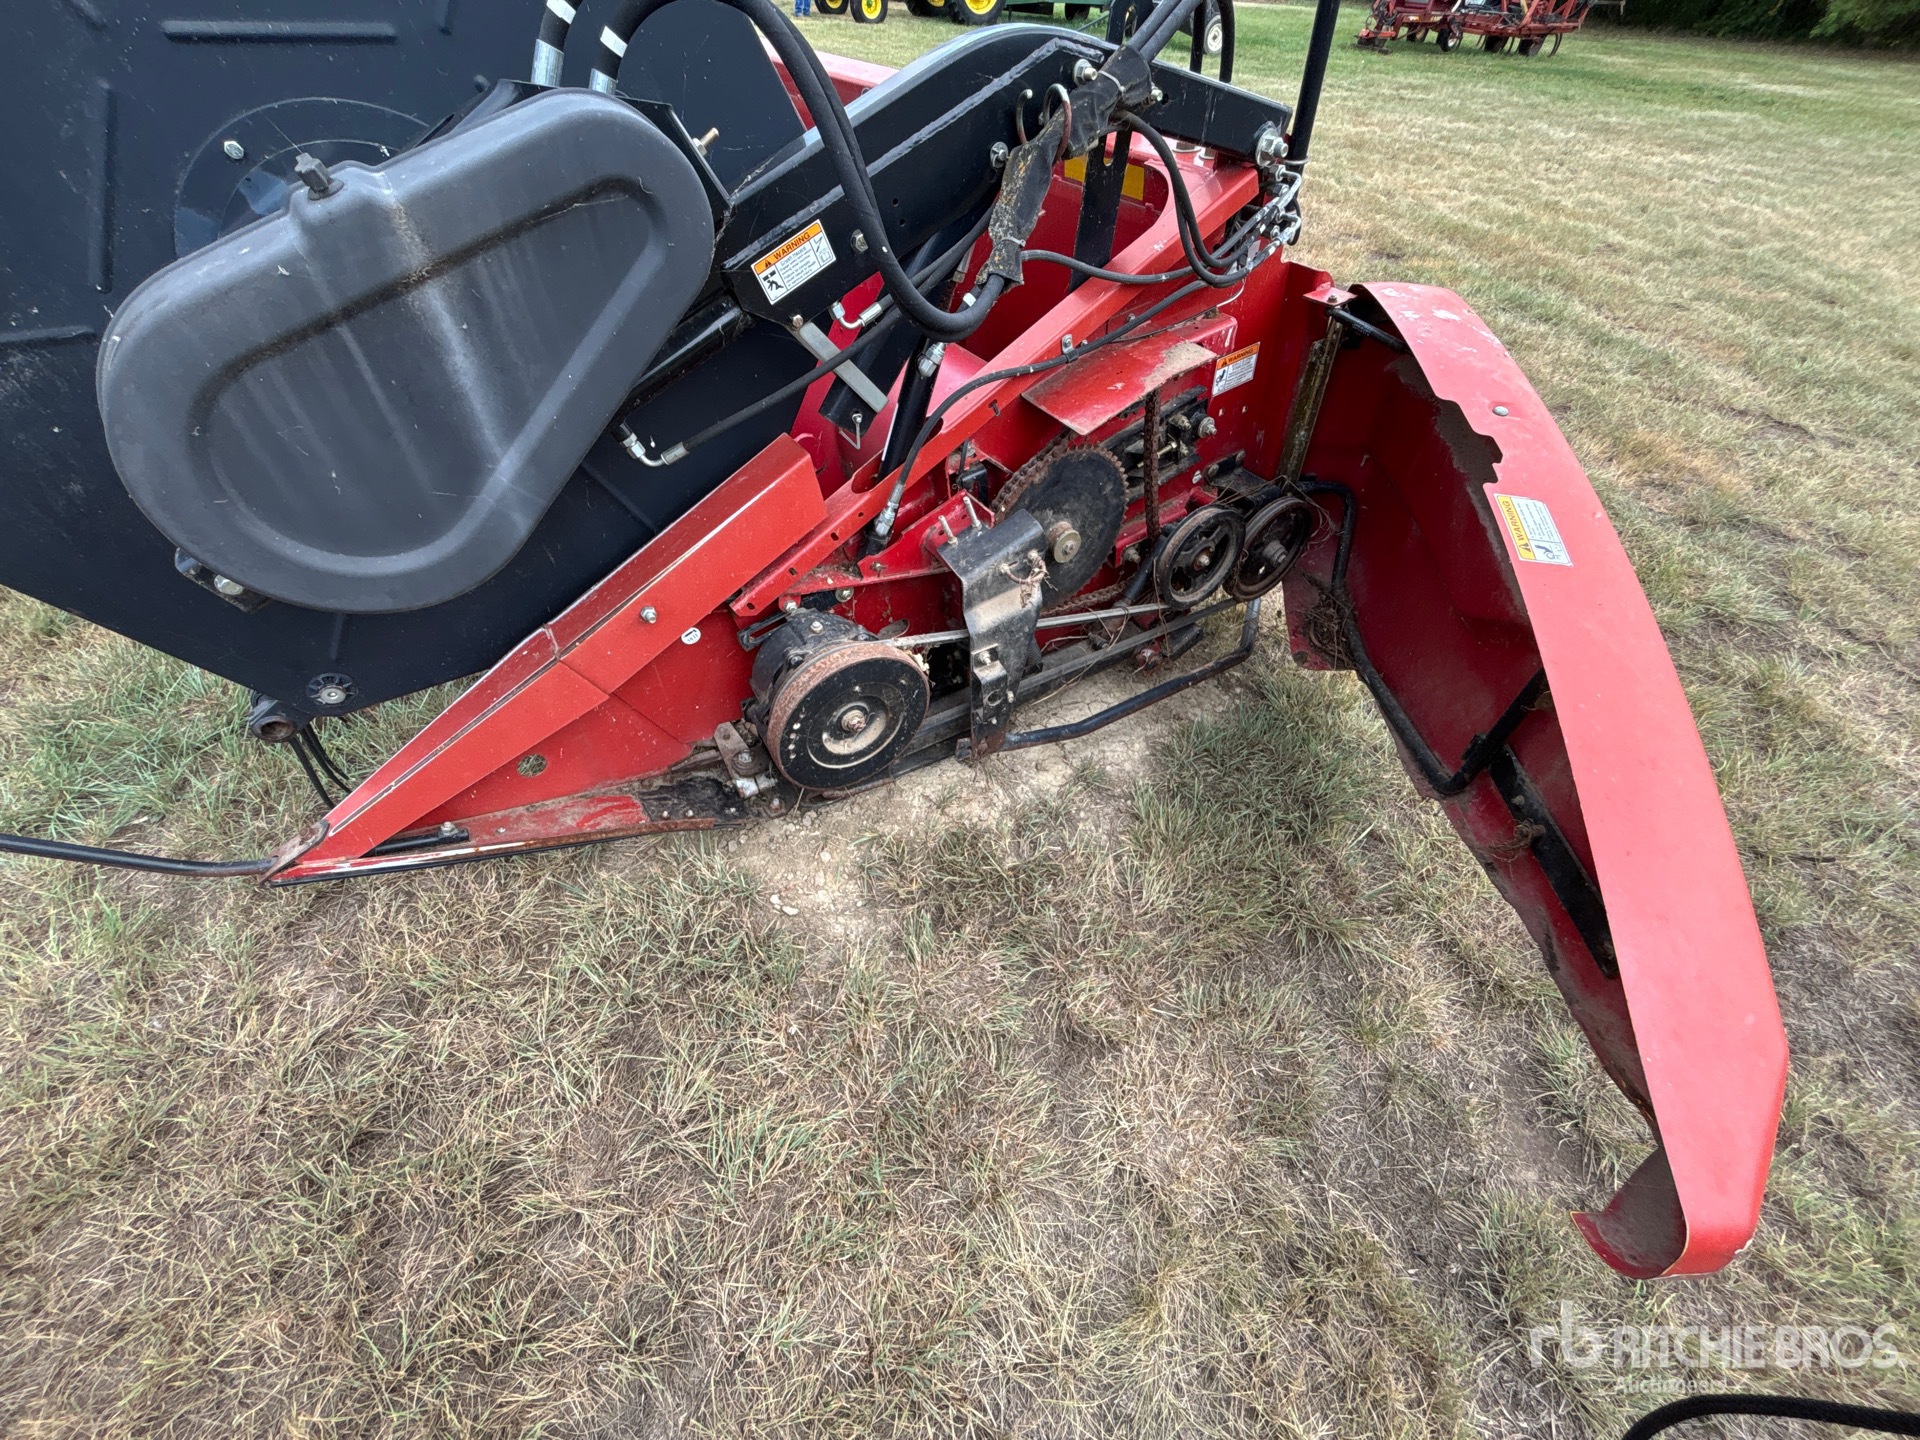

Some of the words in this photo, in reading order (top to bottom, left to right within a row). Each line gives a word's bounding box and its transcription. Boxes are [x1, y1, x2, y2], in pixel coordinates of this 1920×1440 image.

[773, 231, 811, 260] WARNING
[1228, 347, 1253, 363] WARNING
[1502, 500, 1525, 541] WARNING
